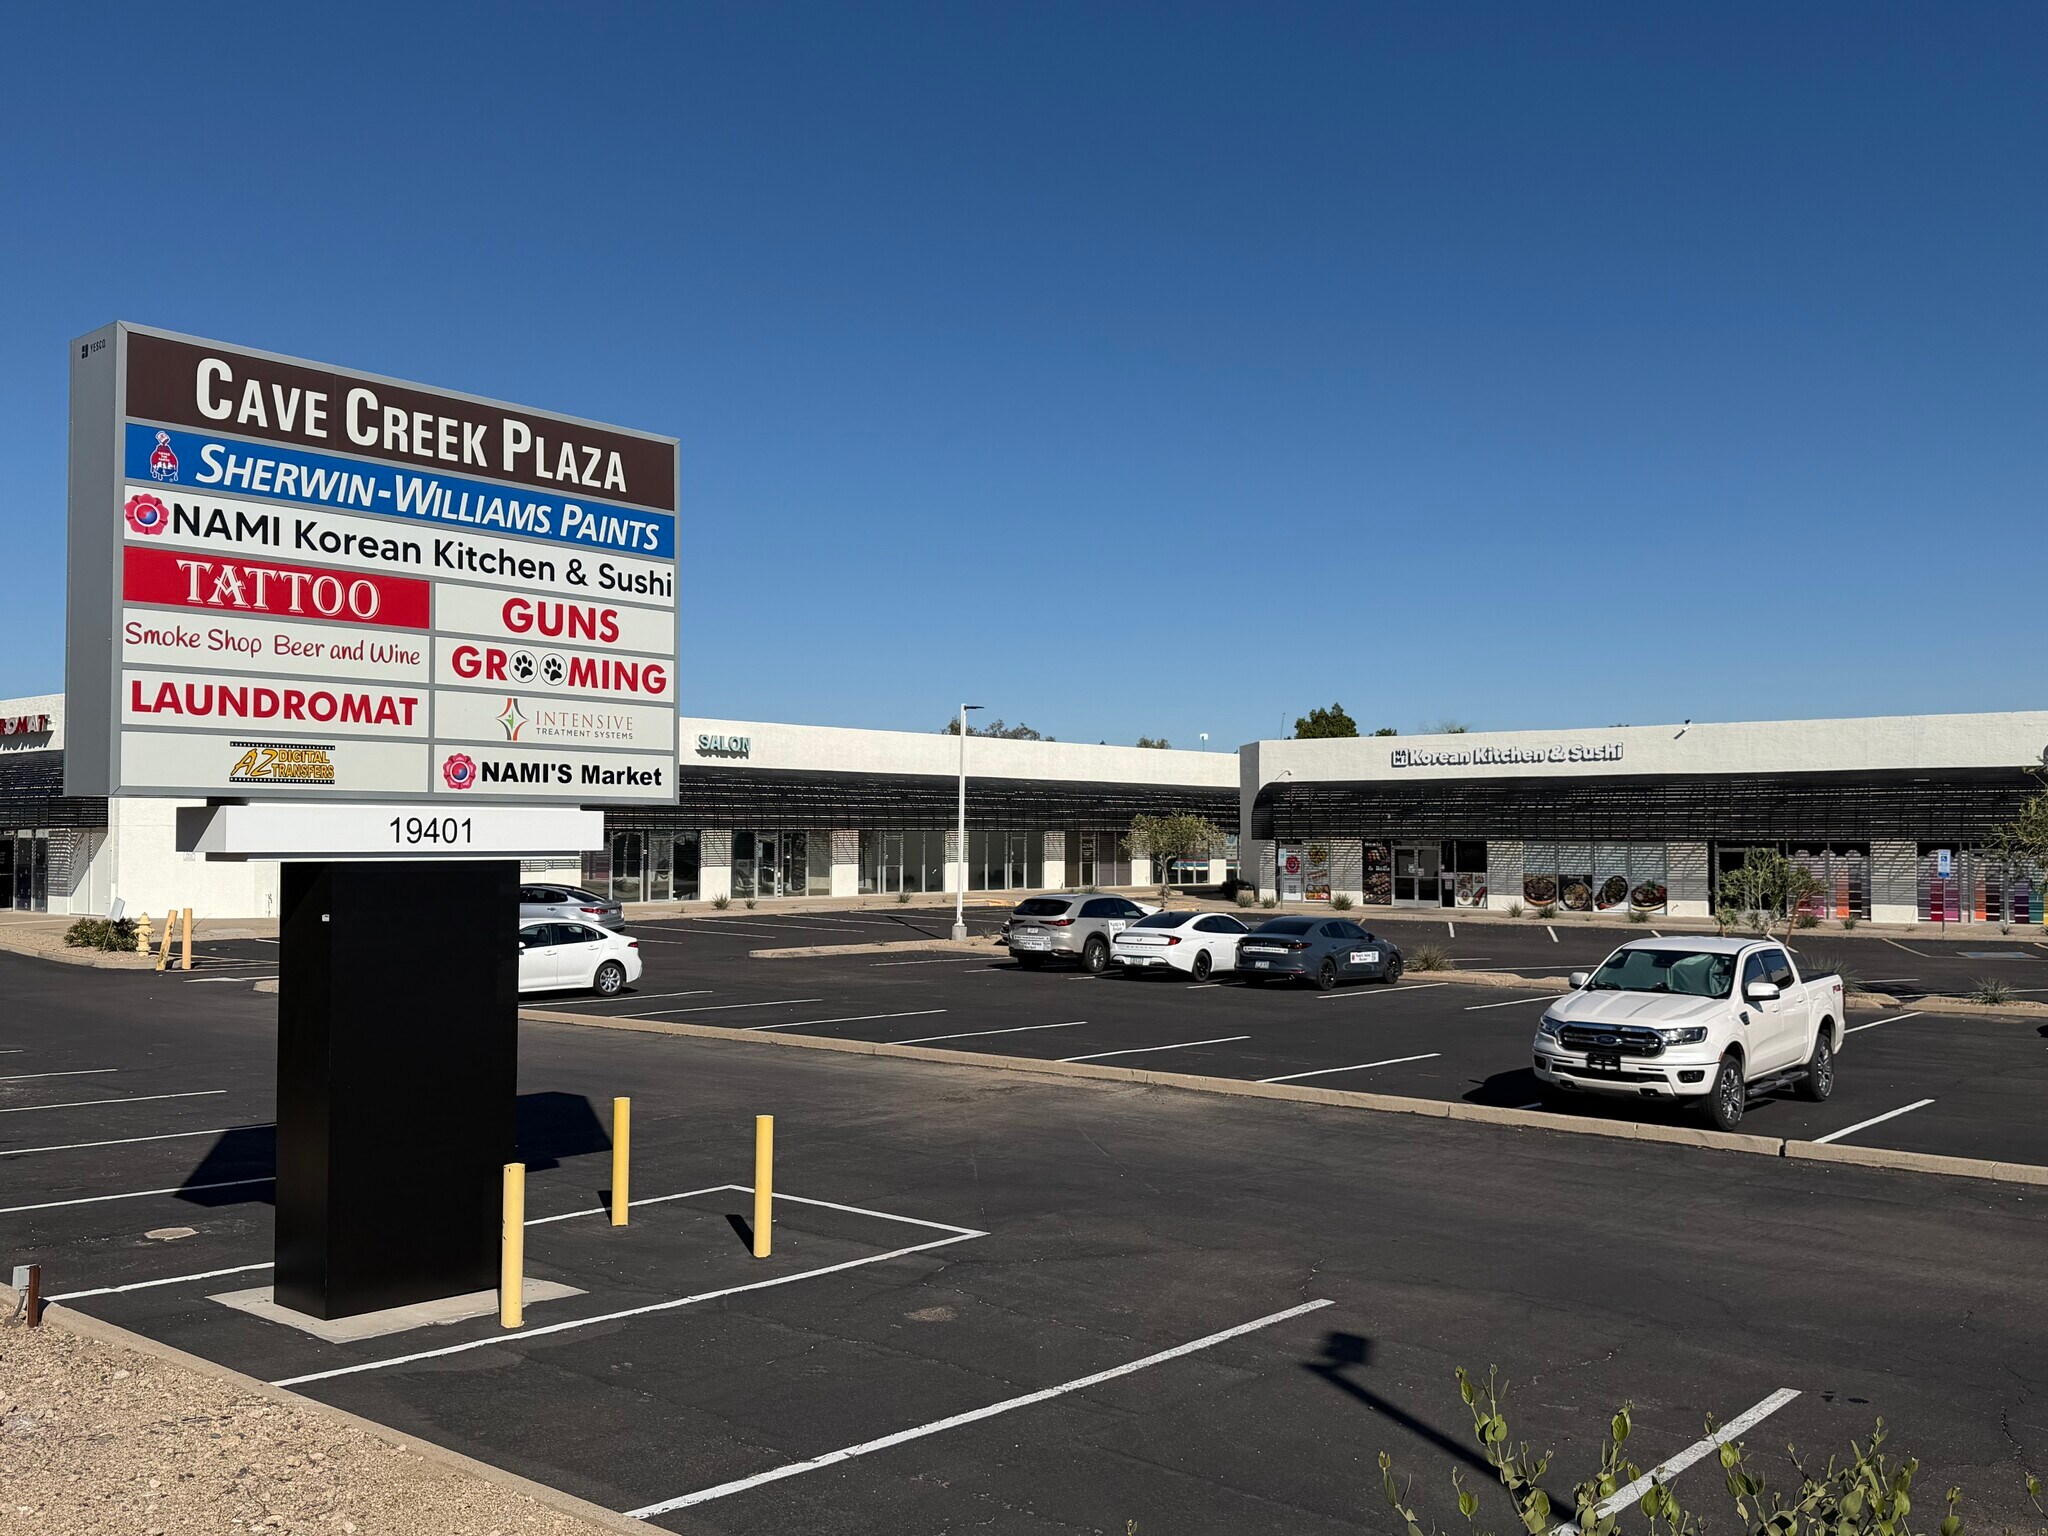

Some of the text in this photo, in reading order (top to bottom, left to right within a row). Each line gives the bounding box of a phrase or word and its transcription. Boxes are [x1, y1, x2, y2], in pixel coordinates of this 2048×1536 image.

[90, 338, 106, 354] YESCO
[196, 358, 627, 493] CAVE CREEK PLAZA
[195, 443, 660, 551] SHERWIN-WILLIAMS PAINTS
[173, 503, 672, 597] NAMI Korean Kitchen & Sushi
[176, 559, 381, 620] TATTOO
[502, 597, 620, 643] GUNS
[125, 622, 421, 665] Smoke Shop Beer and Wine
[131, 680, 418, 726] LAUNDROMAT
[535, 710, 633, 731] INTENSIVE
[536, 727, 633, 740] TREATMENT SYSTEMS
[698, 734, 751, 752] SALON
[1409, 742, 1624, 766] Korean Kitchen & Sushi
[278, 749, 330, 764] DIGITAL
[271, 763, 335, 779] TRANSFERS
[481, 761, 662, 786] NAMI'S Market
[390, 816, 471, 844] 19401
